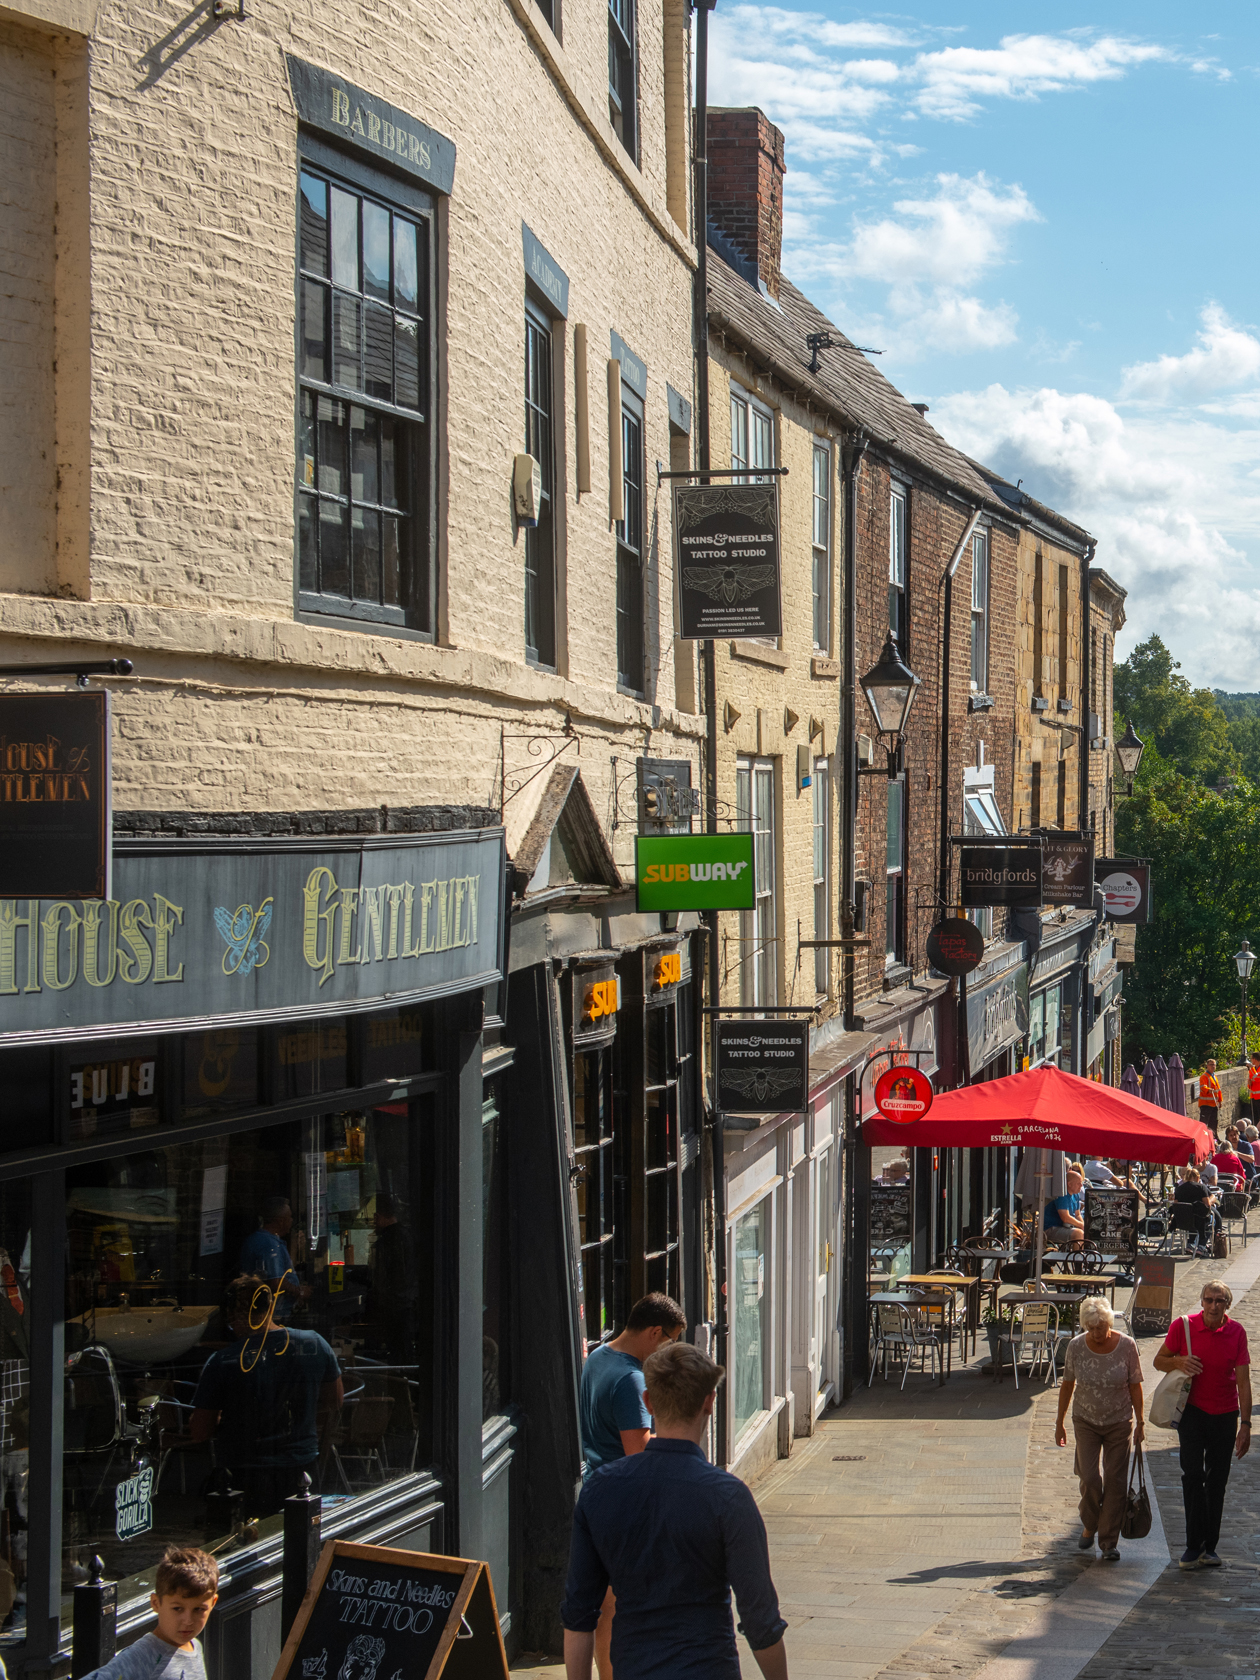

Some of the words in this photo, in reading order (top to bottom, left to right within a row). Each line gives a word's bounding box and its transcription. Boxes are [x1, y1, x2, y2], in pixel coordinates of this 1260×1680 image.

[331, 87, 431, 170] BARBERS
[690, 550, 727, 559] TATTOO
[731, 549, 767, 557] STUDIO
[643, 860, 748, 884] SUBWAY
[967, 868, 1037, 884] bridgfords
[1103, 884, 1137, 893] Chapters
[302, 867, 482, 987] GENTLEMEN
[728, 1050, 760, 1058] TATTOO
[764, 1050, 795, 1058] STUDIO
[883, 1101, 923, 1110] Cruzcampo
[990, 1134, 1022, 1142] ESTRELLA
[1018, 1125, 1059, 1134] BARCELONA
[116, 1478, 139, 1507] SLICK
[117, 1503, 148, 1533] GORILLA
[326, 1569, 368, 1594] Skins
[368, 1578, 403, 1600] and
[402, 1580, 456, 1609] Needles
[339, 1596, 433, 1634] TATTOO
